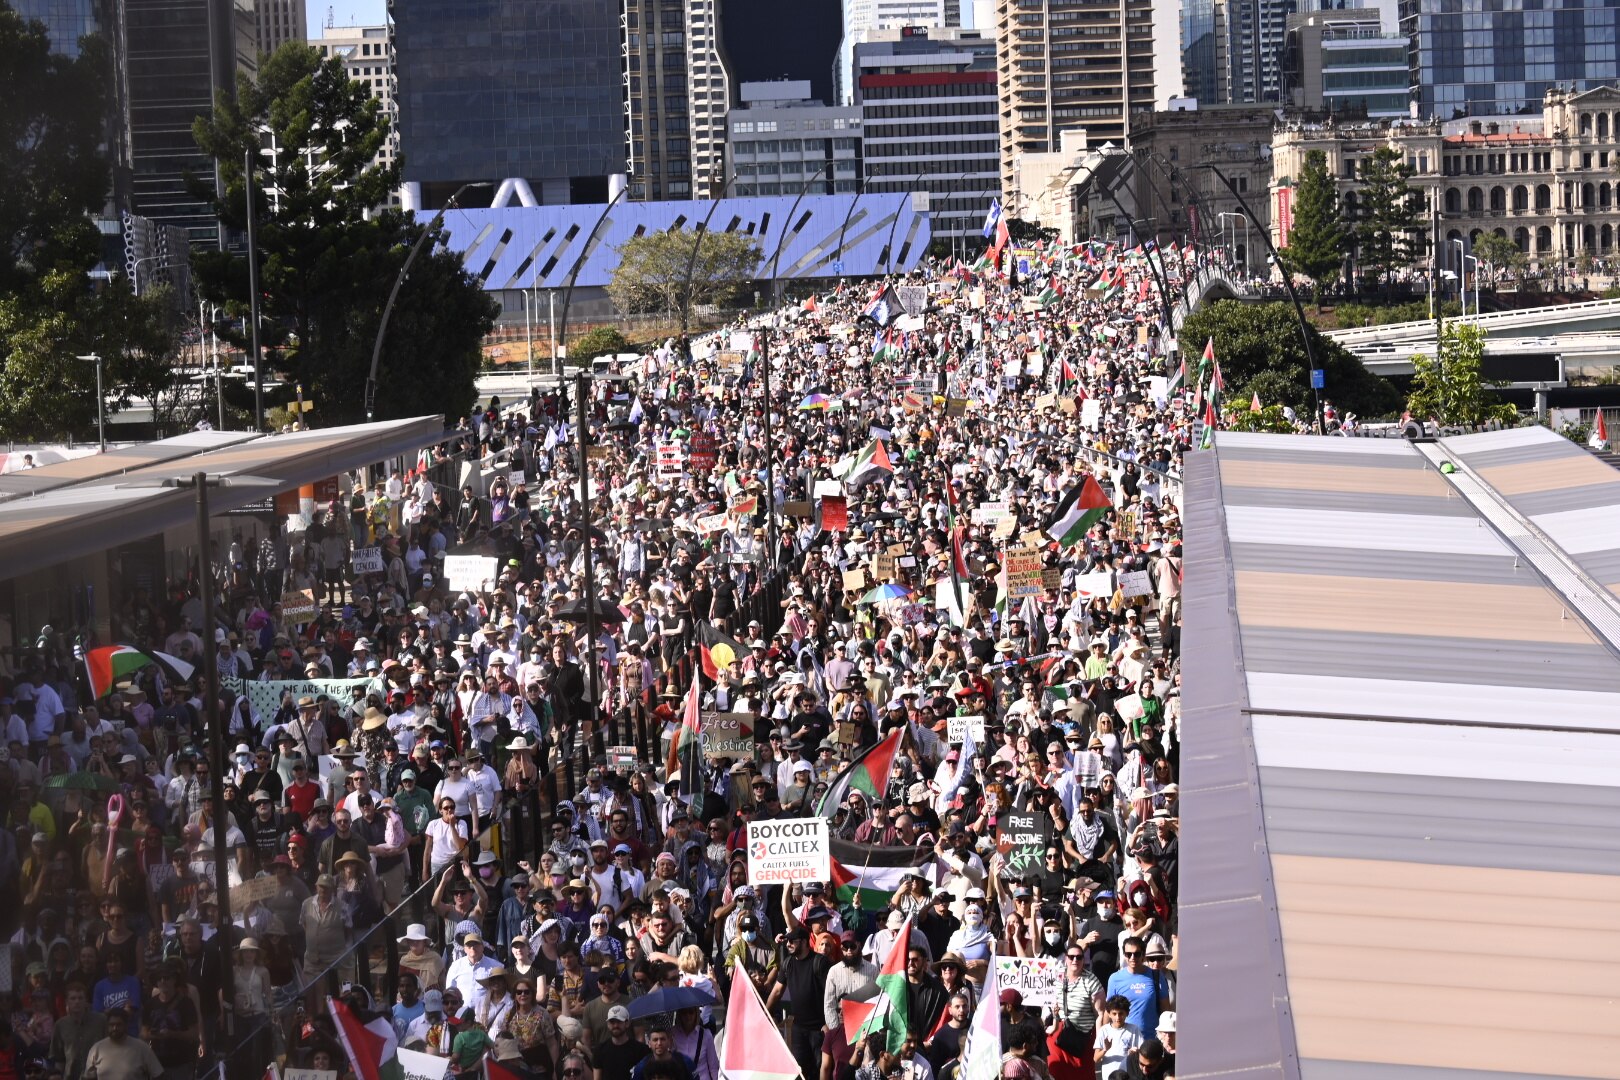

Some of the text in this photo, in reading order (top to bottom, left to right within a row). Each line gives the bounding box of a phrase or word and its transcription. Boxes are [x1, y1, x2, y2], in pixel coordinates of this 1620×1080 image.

[1006, 548, 1036, 558] The number
[1030, 556, 1035, 564] of
[1007, 563, 1041, 573] CHILD DEATHS
[1027, 570, 1041, 579] WORLD
[1014, 586, 1040, 595] ISRAEL
[283, 604, 315, 616] RECOGNISE
[302, 684, 319, 694] ARE
[324, 684, 342, 694] THE
[701, 712, 739, 731] Free
[702, 733, 752, 753] Palestine
[1009, 816, 1034, 828] FREE
[751, 823, 820, 839] BOYCOTT
[1000, 833, 1043, 845] PALESTINE
[768, 840, 820, 855] CALTEX
[762, 860, 810, 869] CALTEX FUELS
[755, 868, 817, 881] GENOCIDE
